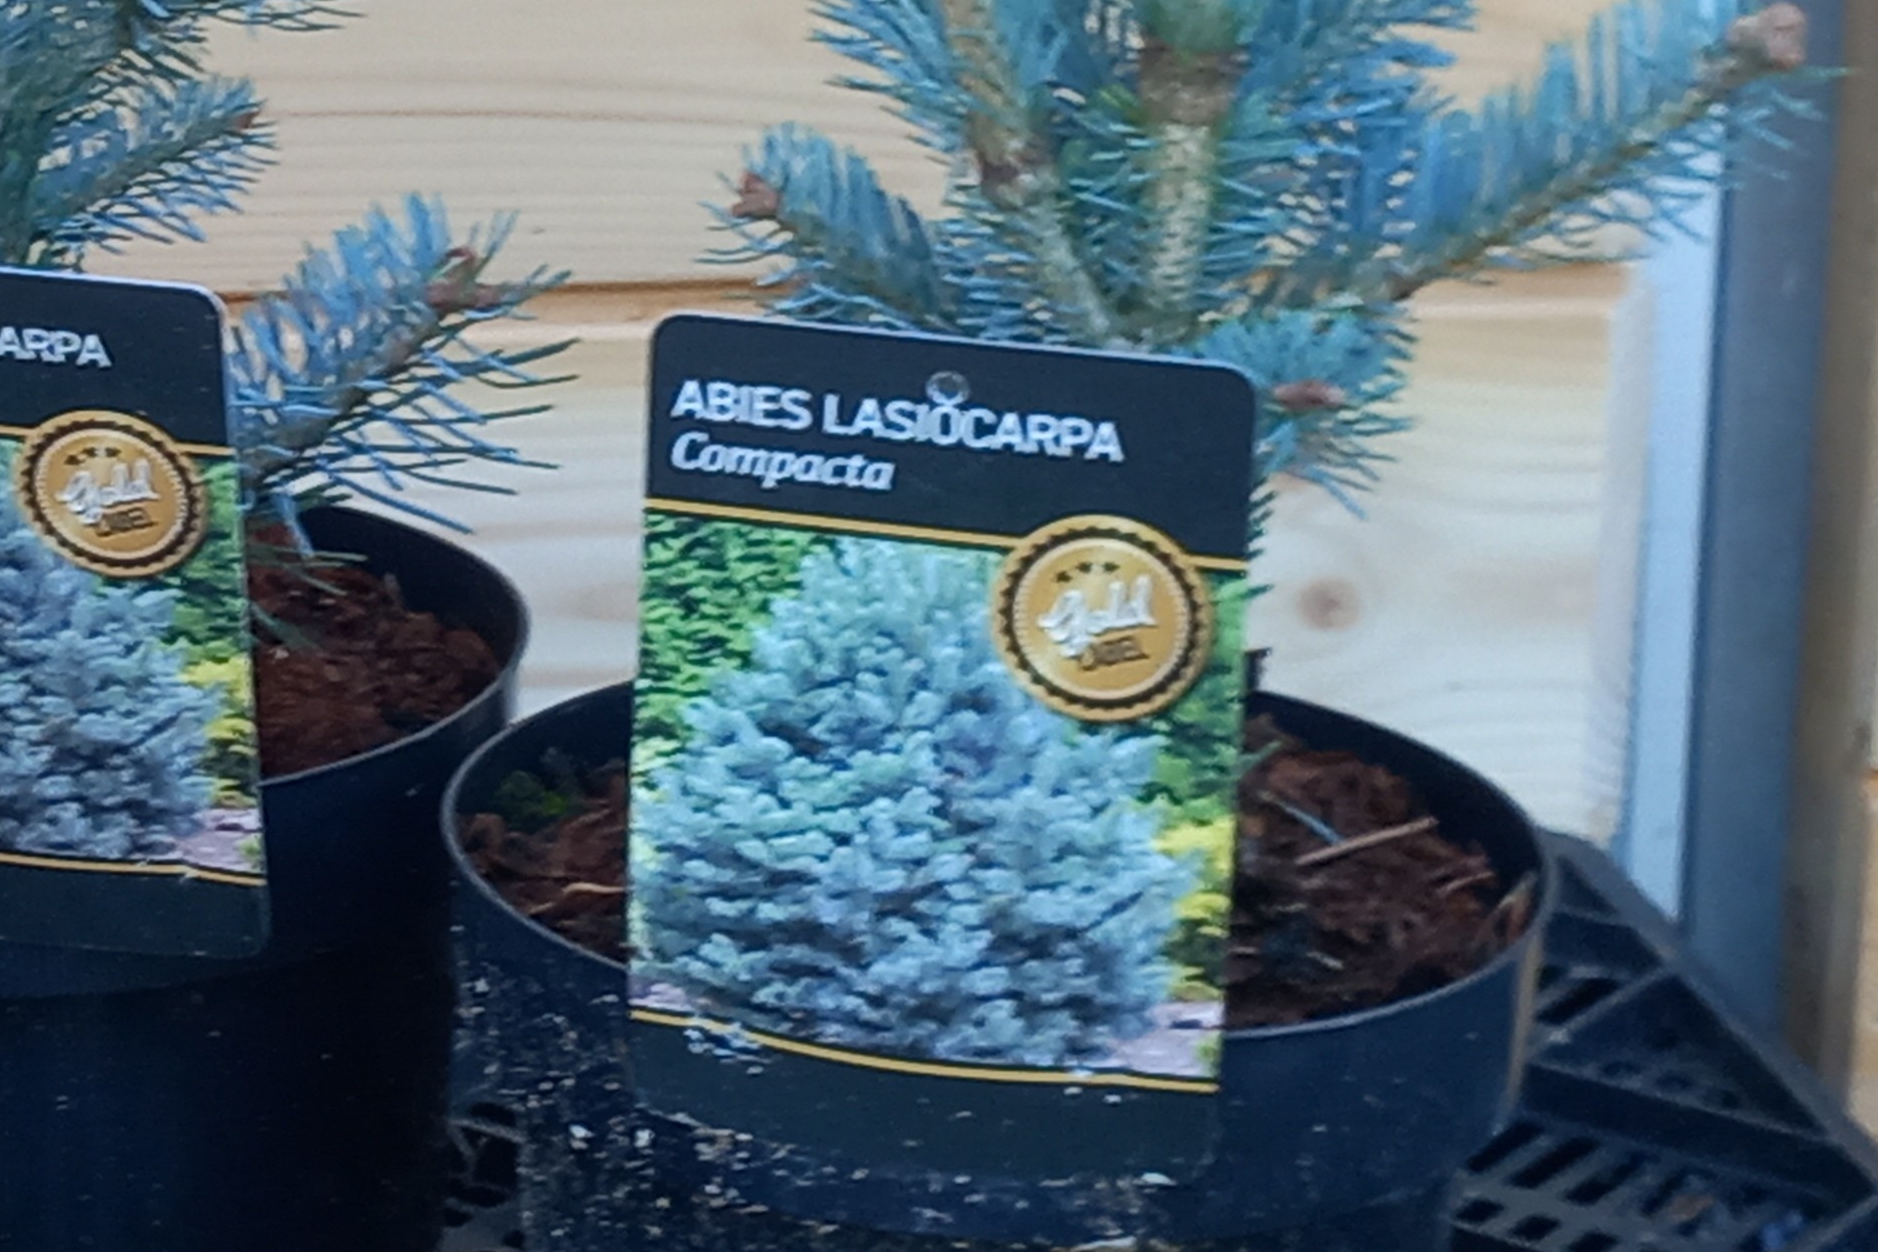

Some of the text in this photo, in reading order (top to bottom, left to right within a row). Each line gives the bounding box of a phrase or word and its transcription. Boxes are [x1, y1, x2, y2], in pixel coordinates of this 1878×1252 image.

[671, 379, 1124, 461] ABIES LASIOCARPA
[671, 432, 895, 490] Compacta
